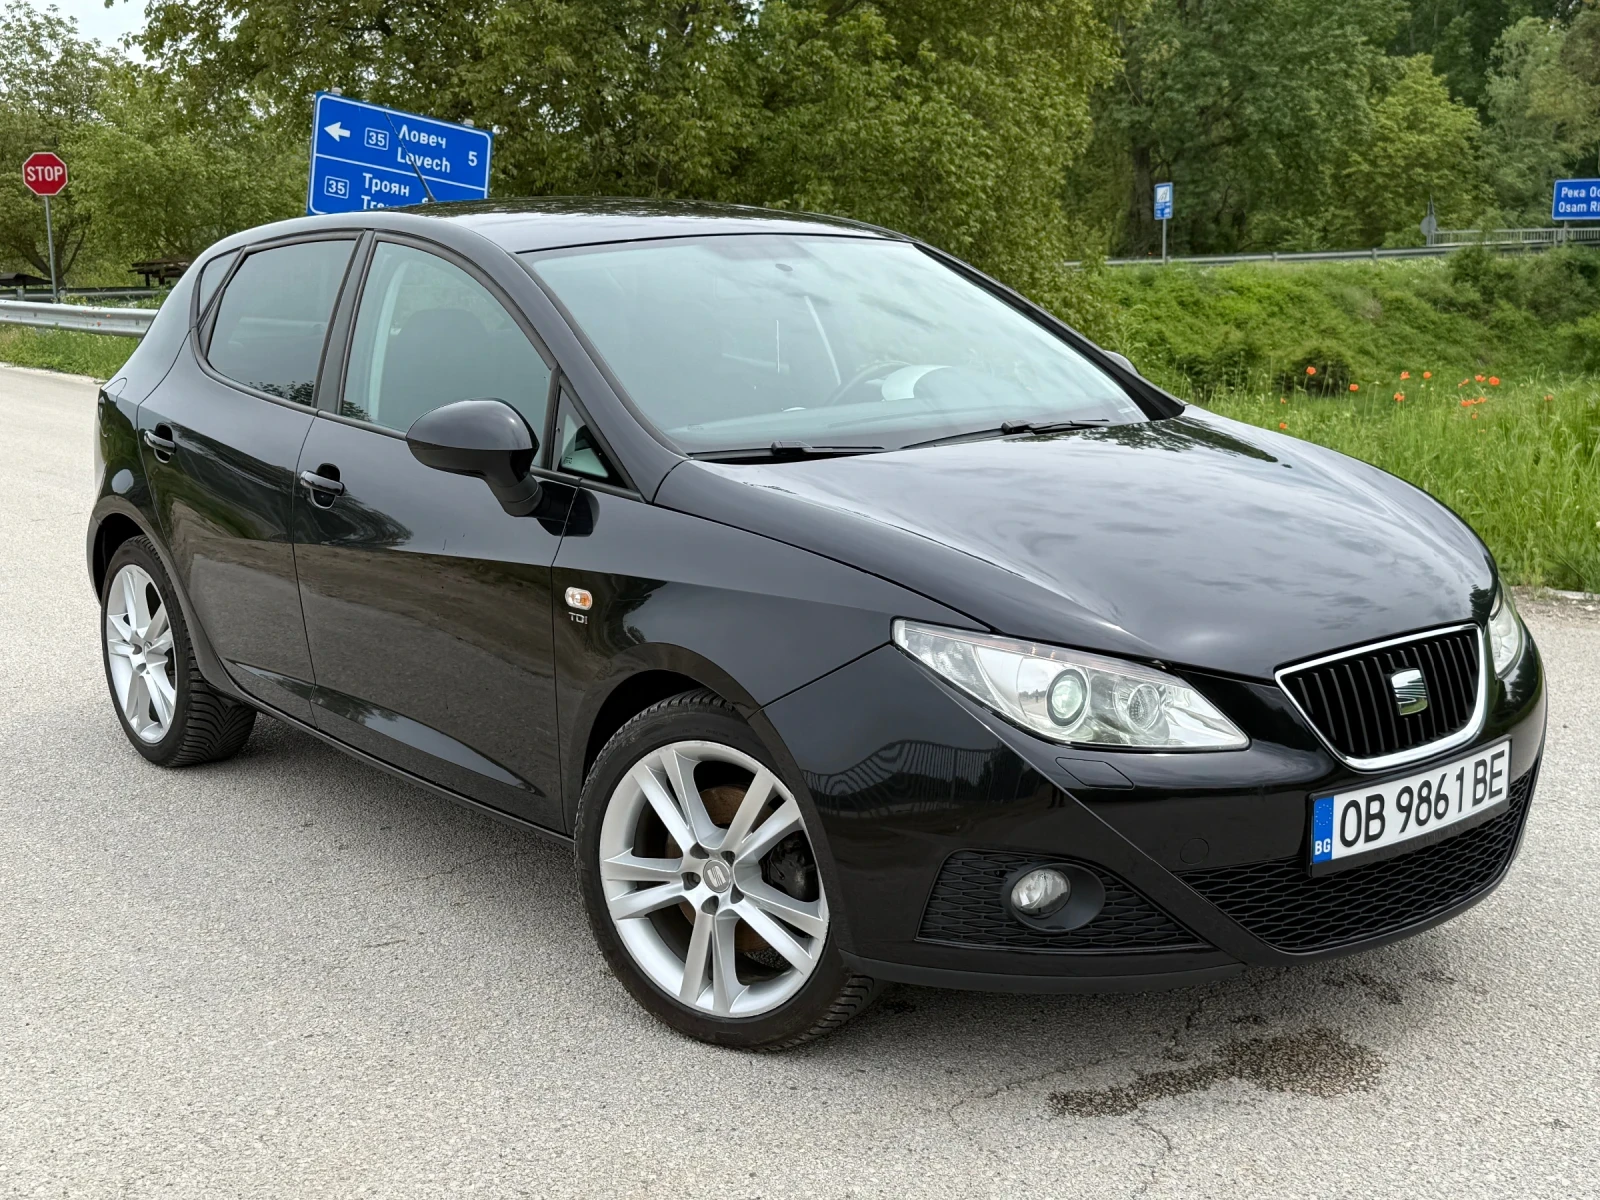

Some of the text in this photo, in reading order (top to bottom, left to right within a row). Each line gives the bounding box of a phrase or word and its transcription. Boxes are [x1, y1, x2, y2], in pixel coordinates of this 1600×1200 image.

[368, 124, 446, 149] 35 Ловеч
[397, 147, 478, 173] Lovech 5
[27, 166, 63, 182] STOP
[328, 172, 409, 197] 35 Троян
[1561, 187, 1586, 198] Река
[1558, 201, 1587, 213] Osam
[568, 611, 588, 624] TDI
[1339, 749, 1505, 847] OB 9861 BE
[1314, 838, 1331, 855] BG
